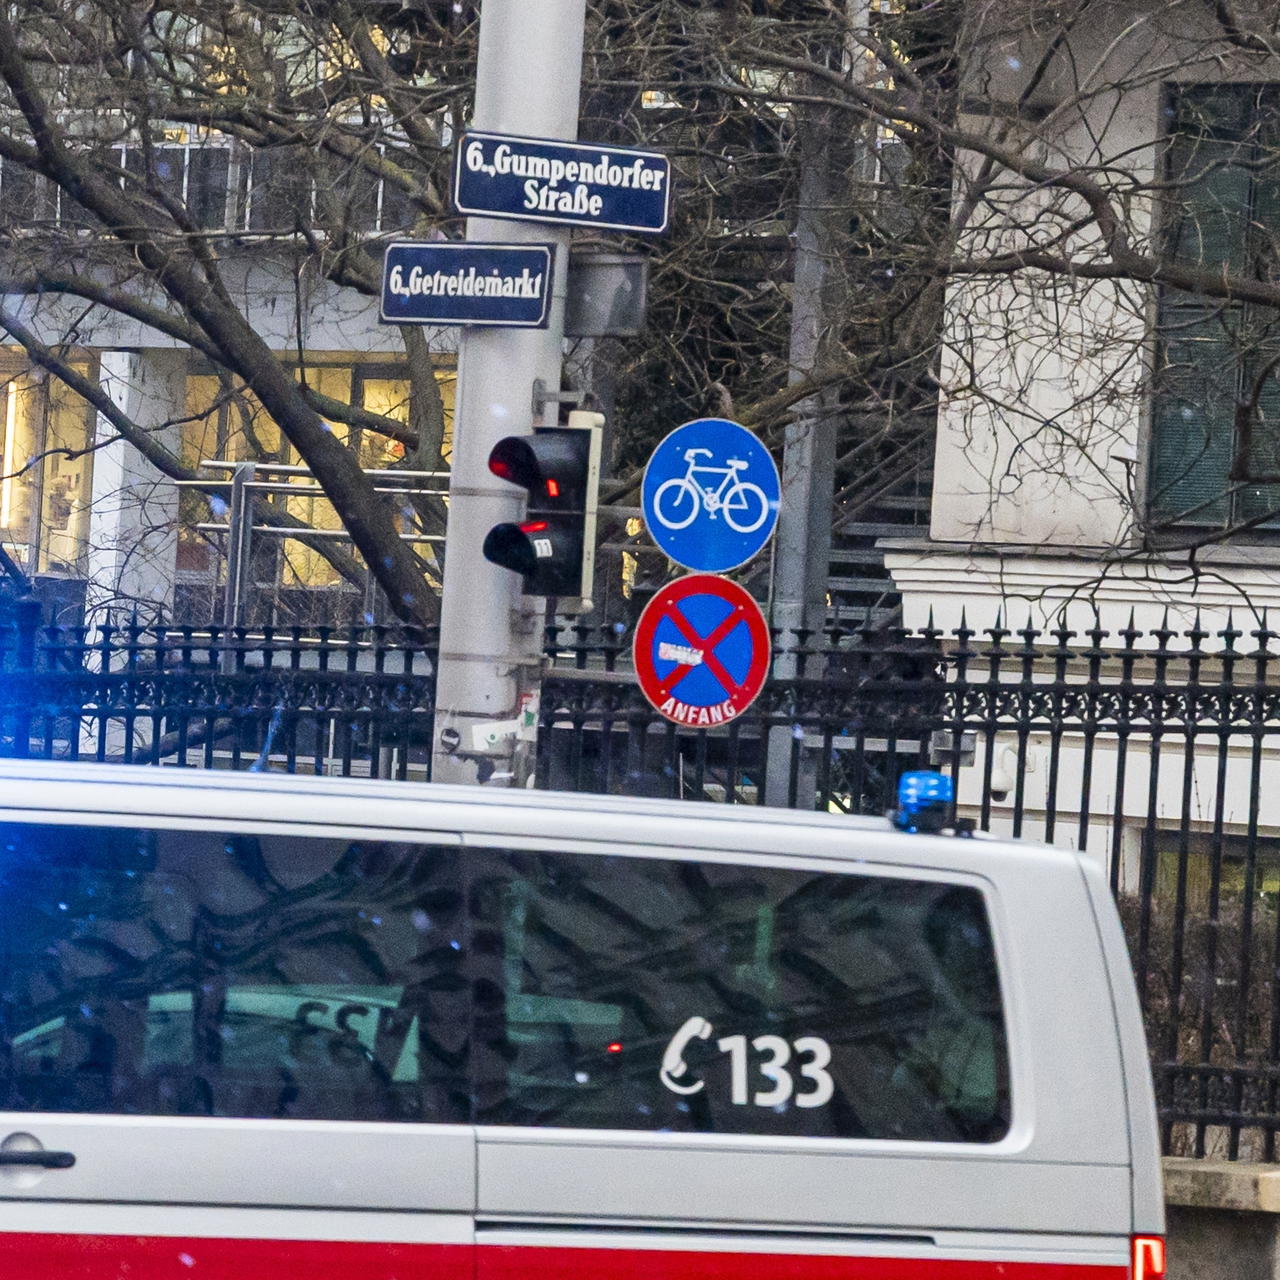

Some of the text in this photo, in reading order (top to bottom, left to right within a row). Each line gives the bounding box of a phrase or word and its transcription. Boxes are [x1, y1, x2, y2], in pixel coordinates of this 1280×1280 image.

[523, 180, 603, 216] Straße
[661, 697, 736, 724] ANFANG
[717, 1034, 834, 1108] 133
